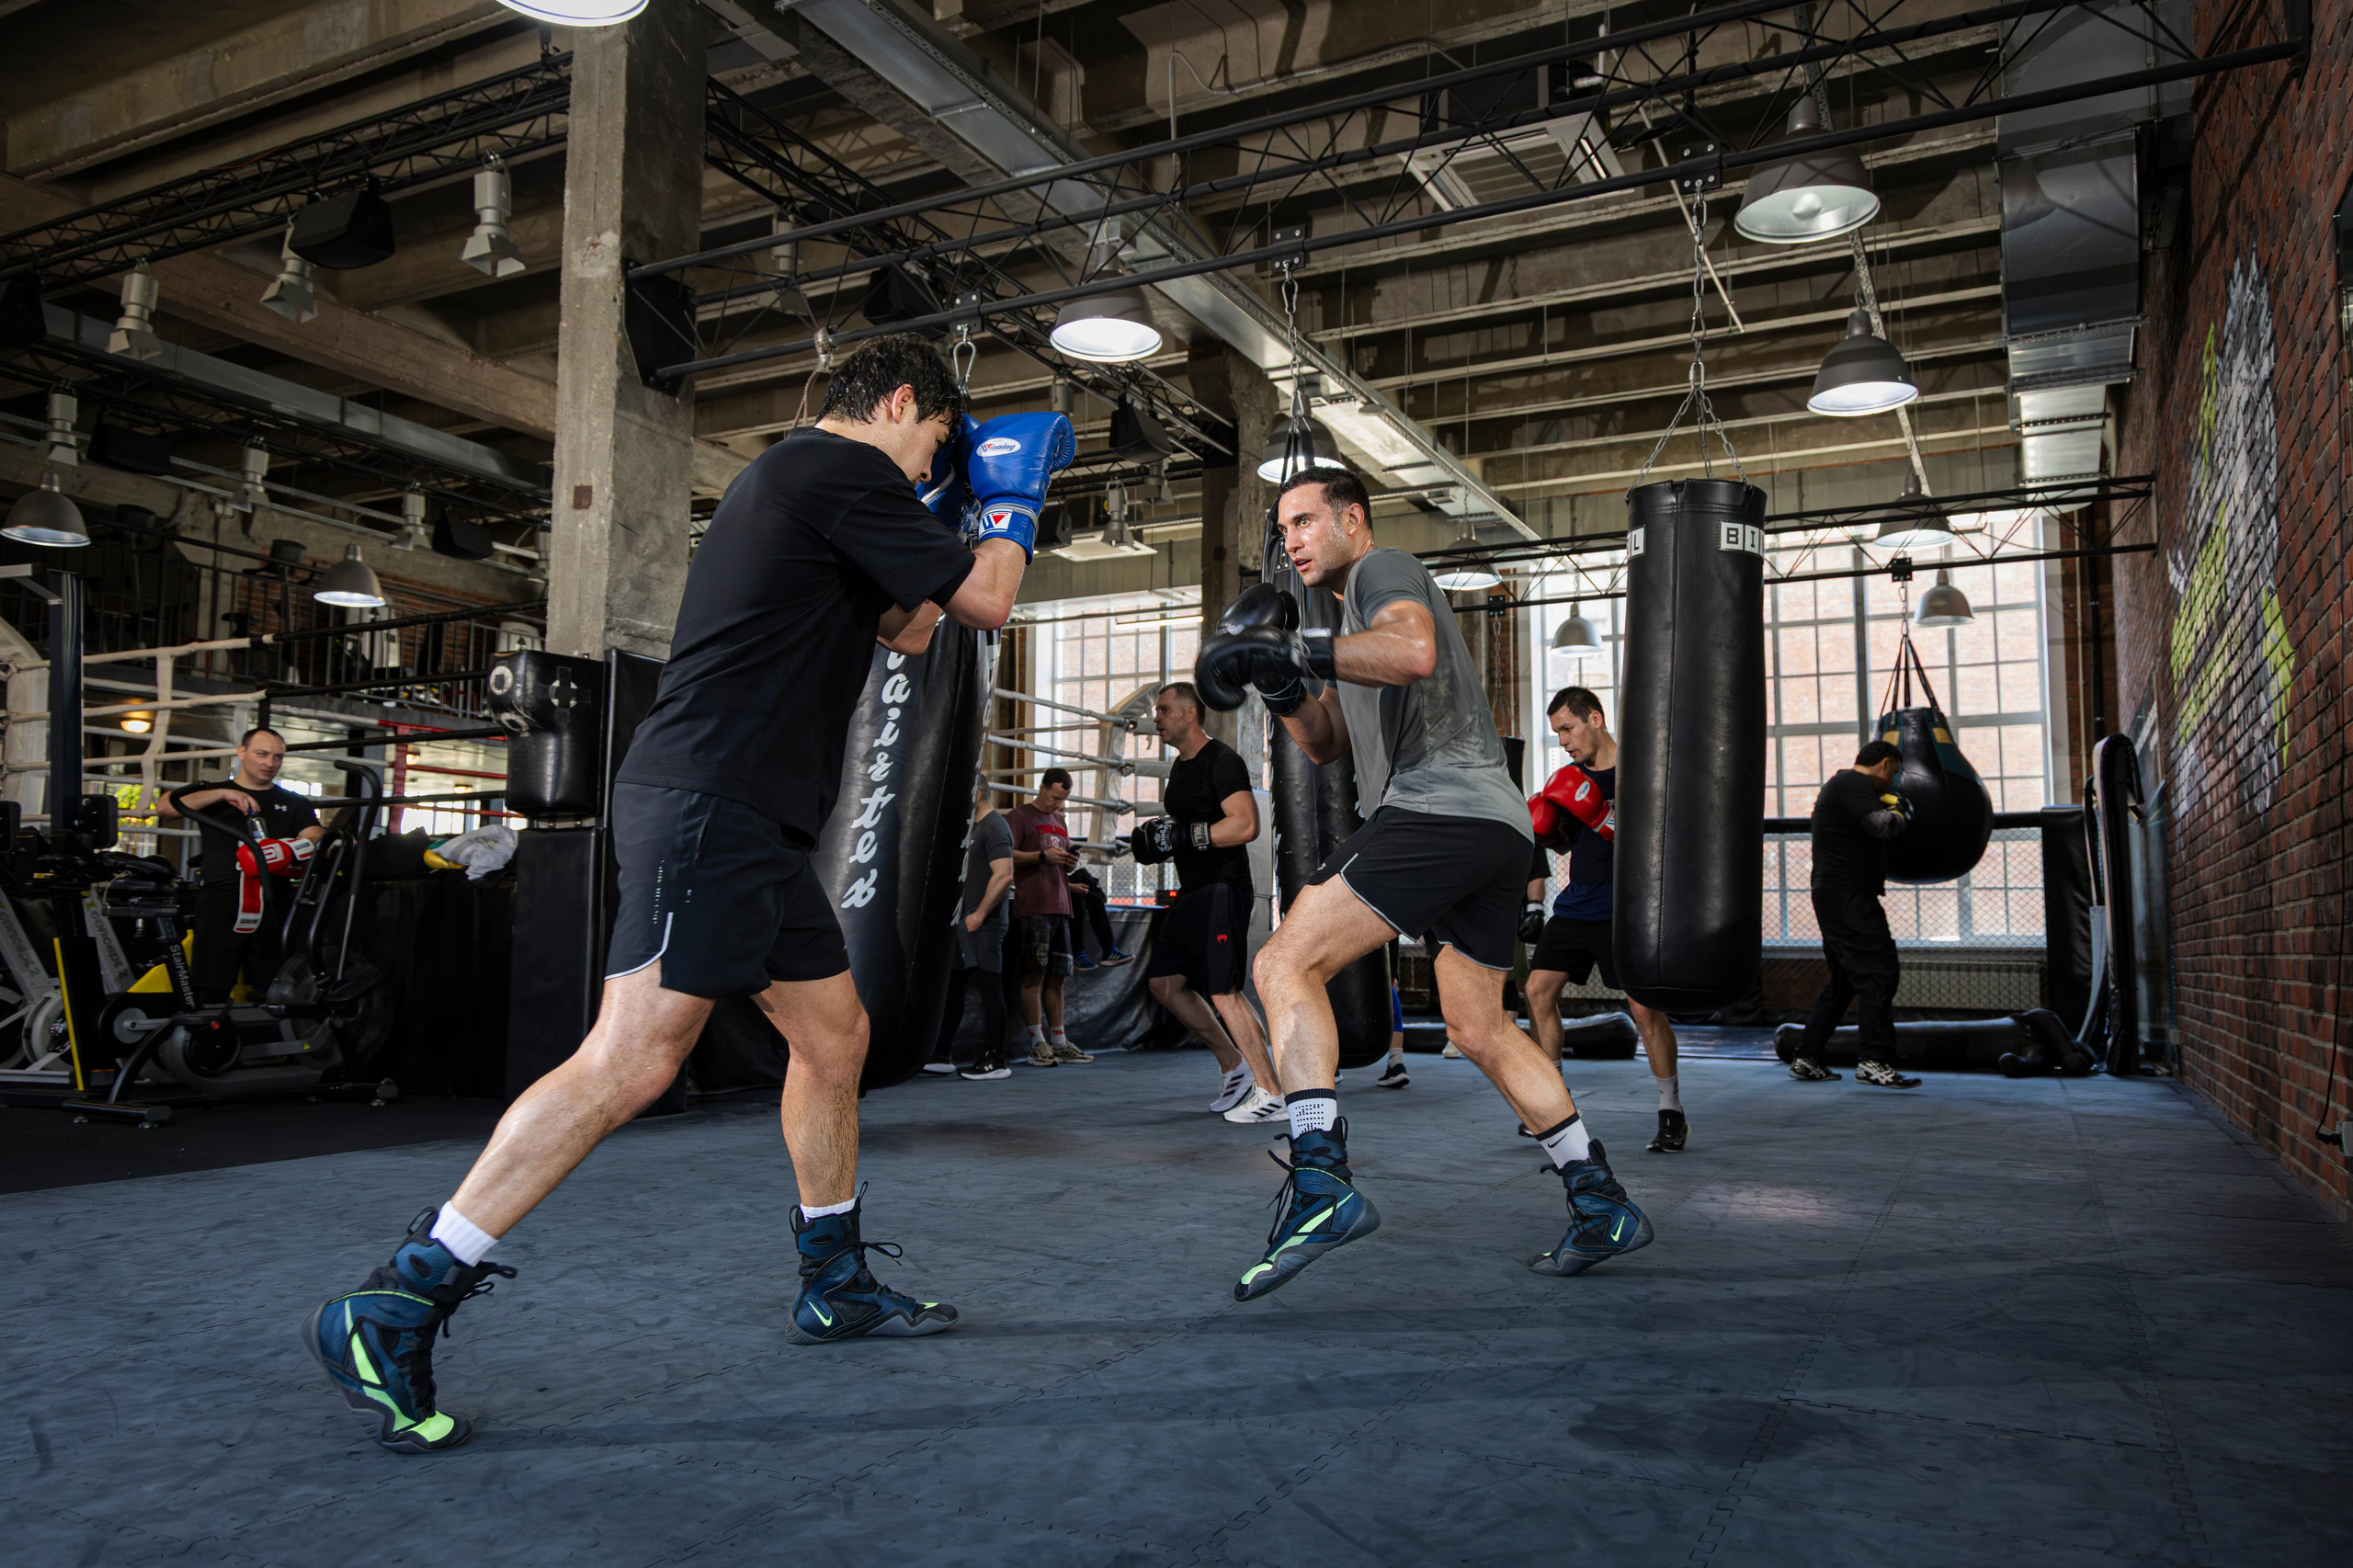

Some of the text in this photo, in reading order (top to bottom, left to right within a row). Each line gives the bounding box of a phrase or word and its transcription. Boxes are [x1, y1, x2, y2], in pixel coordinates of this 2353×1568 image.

[981, 442, 1017, 453] Winning
[1726, 527, 1766, 553] BI
[840, 650, 912, 910] airtex
[91, 910, 128, 980] concept 2
[169, 944, 195, 1008] StairMaster
